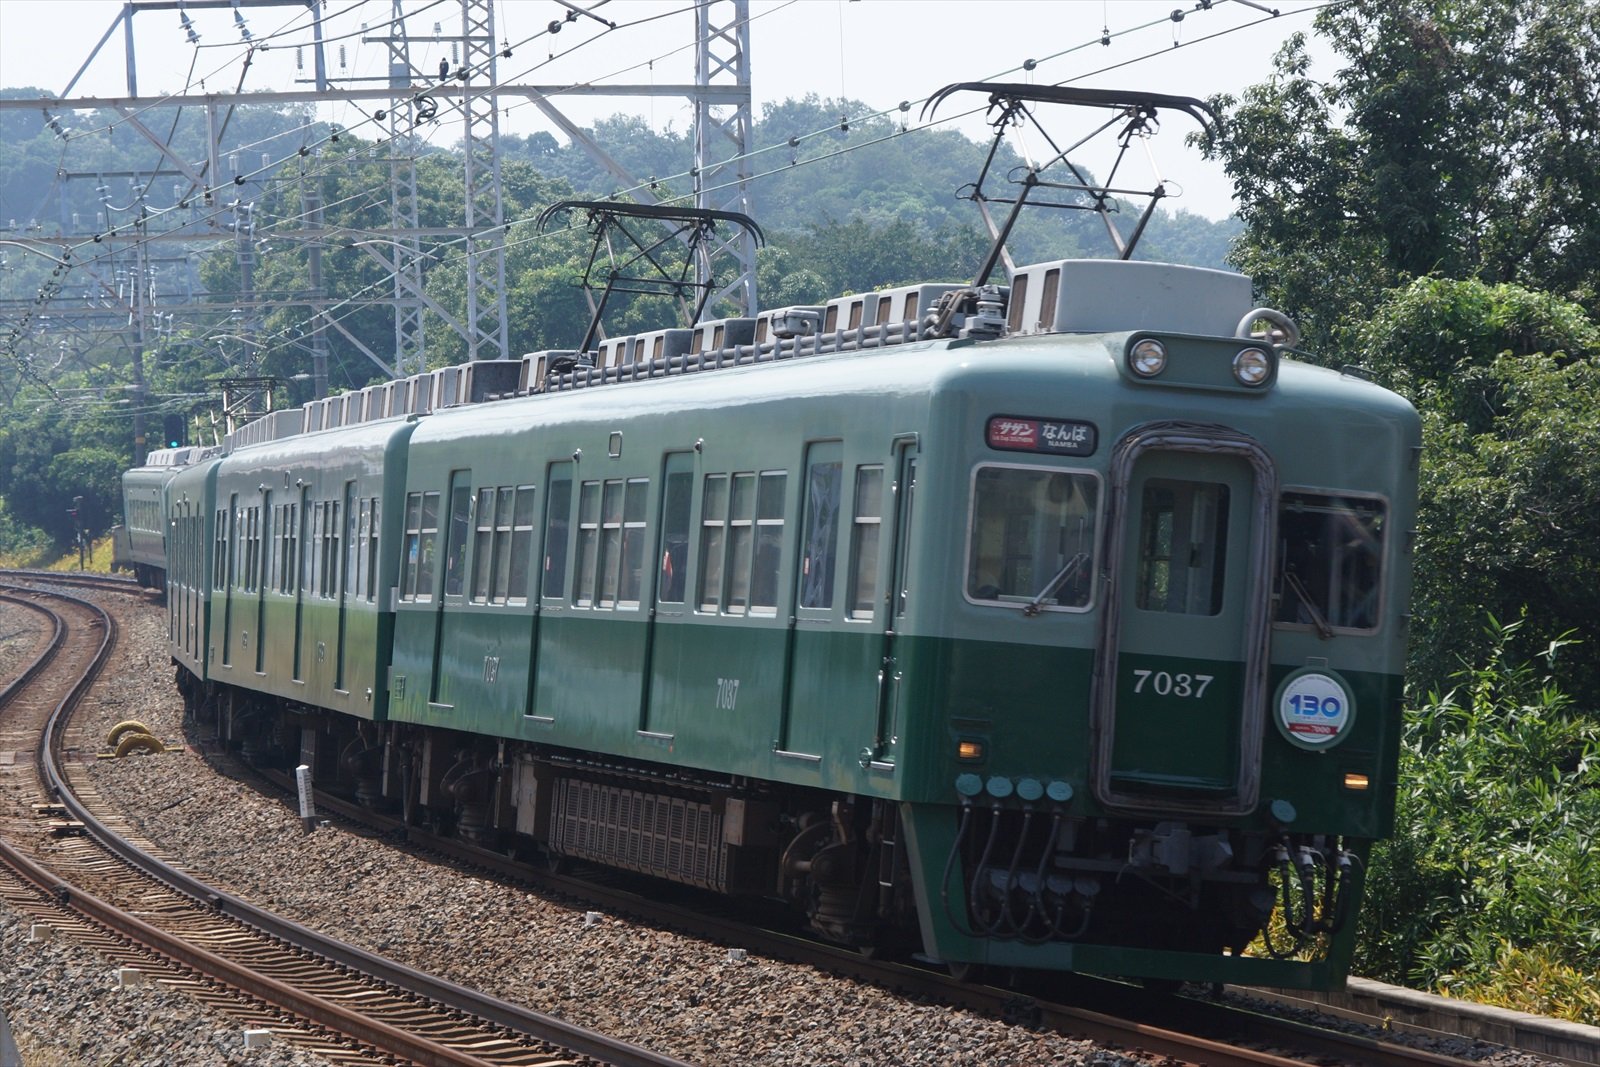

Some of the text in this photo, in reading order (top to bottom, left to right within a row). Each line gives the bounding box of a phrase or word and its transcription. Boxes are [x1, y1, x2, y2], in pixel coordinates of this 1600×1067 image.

[1042, 423, 1088, 441] なんば
[1048, 440, 1078, 448] NAMBA
[483, 655, 500, 683] 7037
[716, 677, 740, 710] 7037
[1133, 669, 1214, 698] 7037
[1289, 694, 1341, 718] 130
